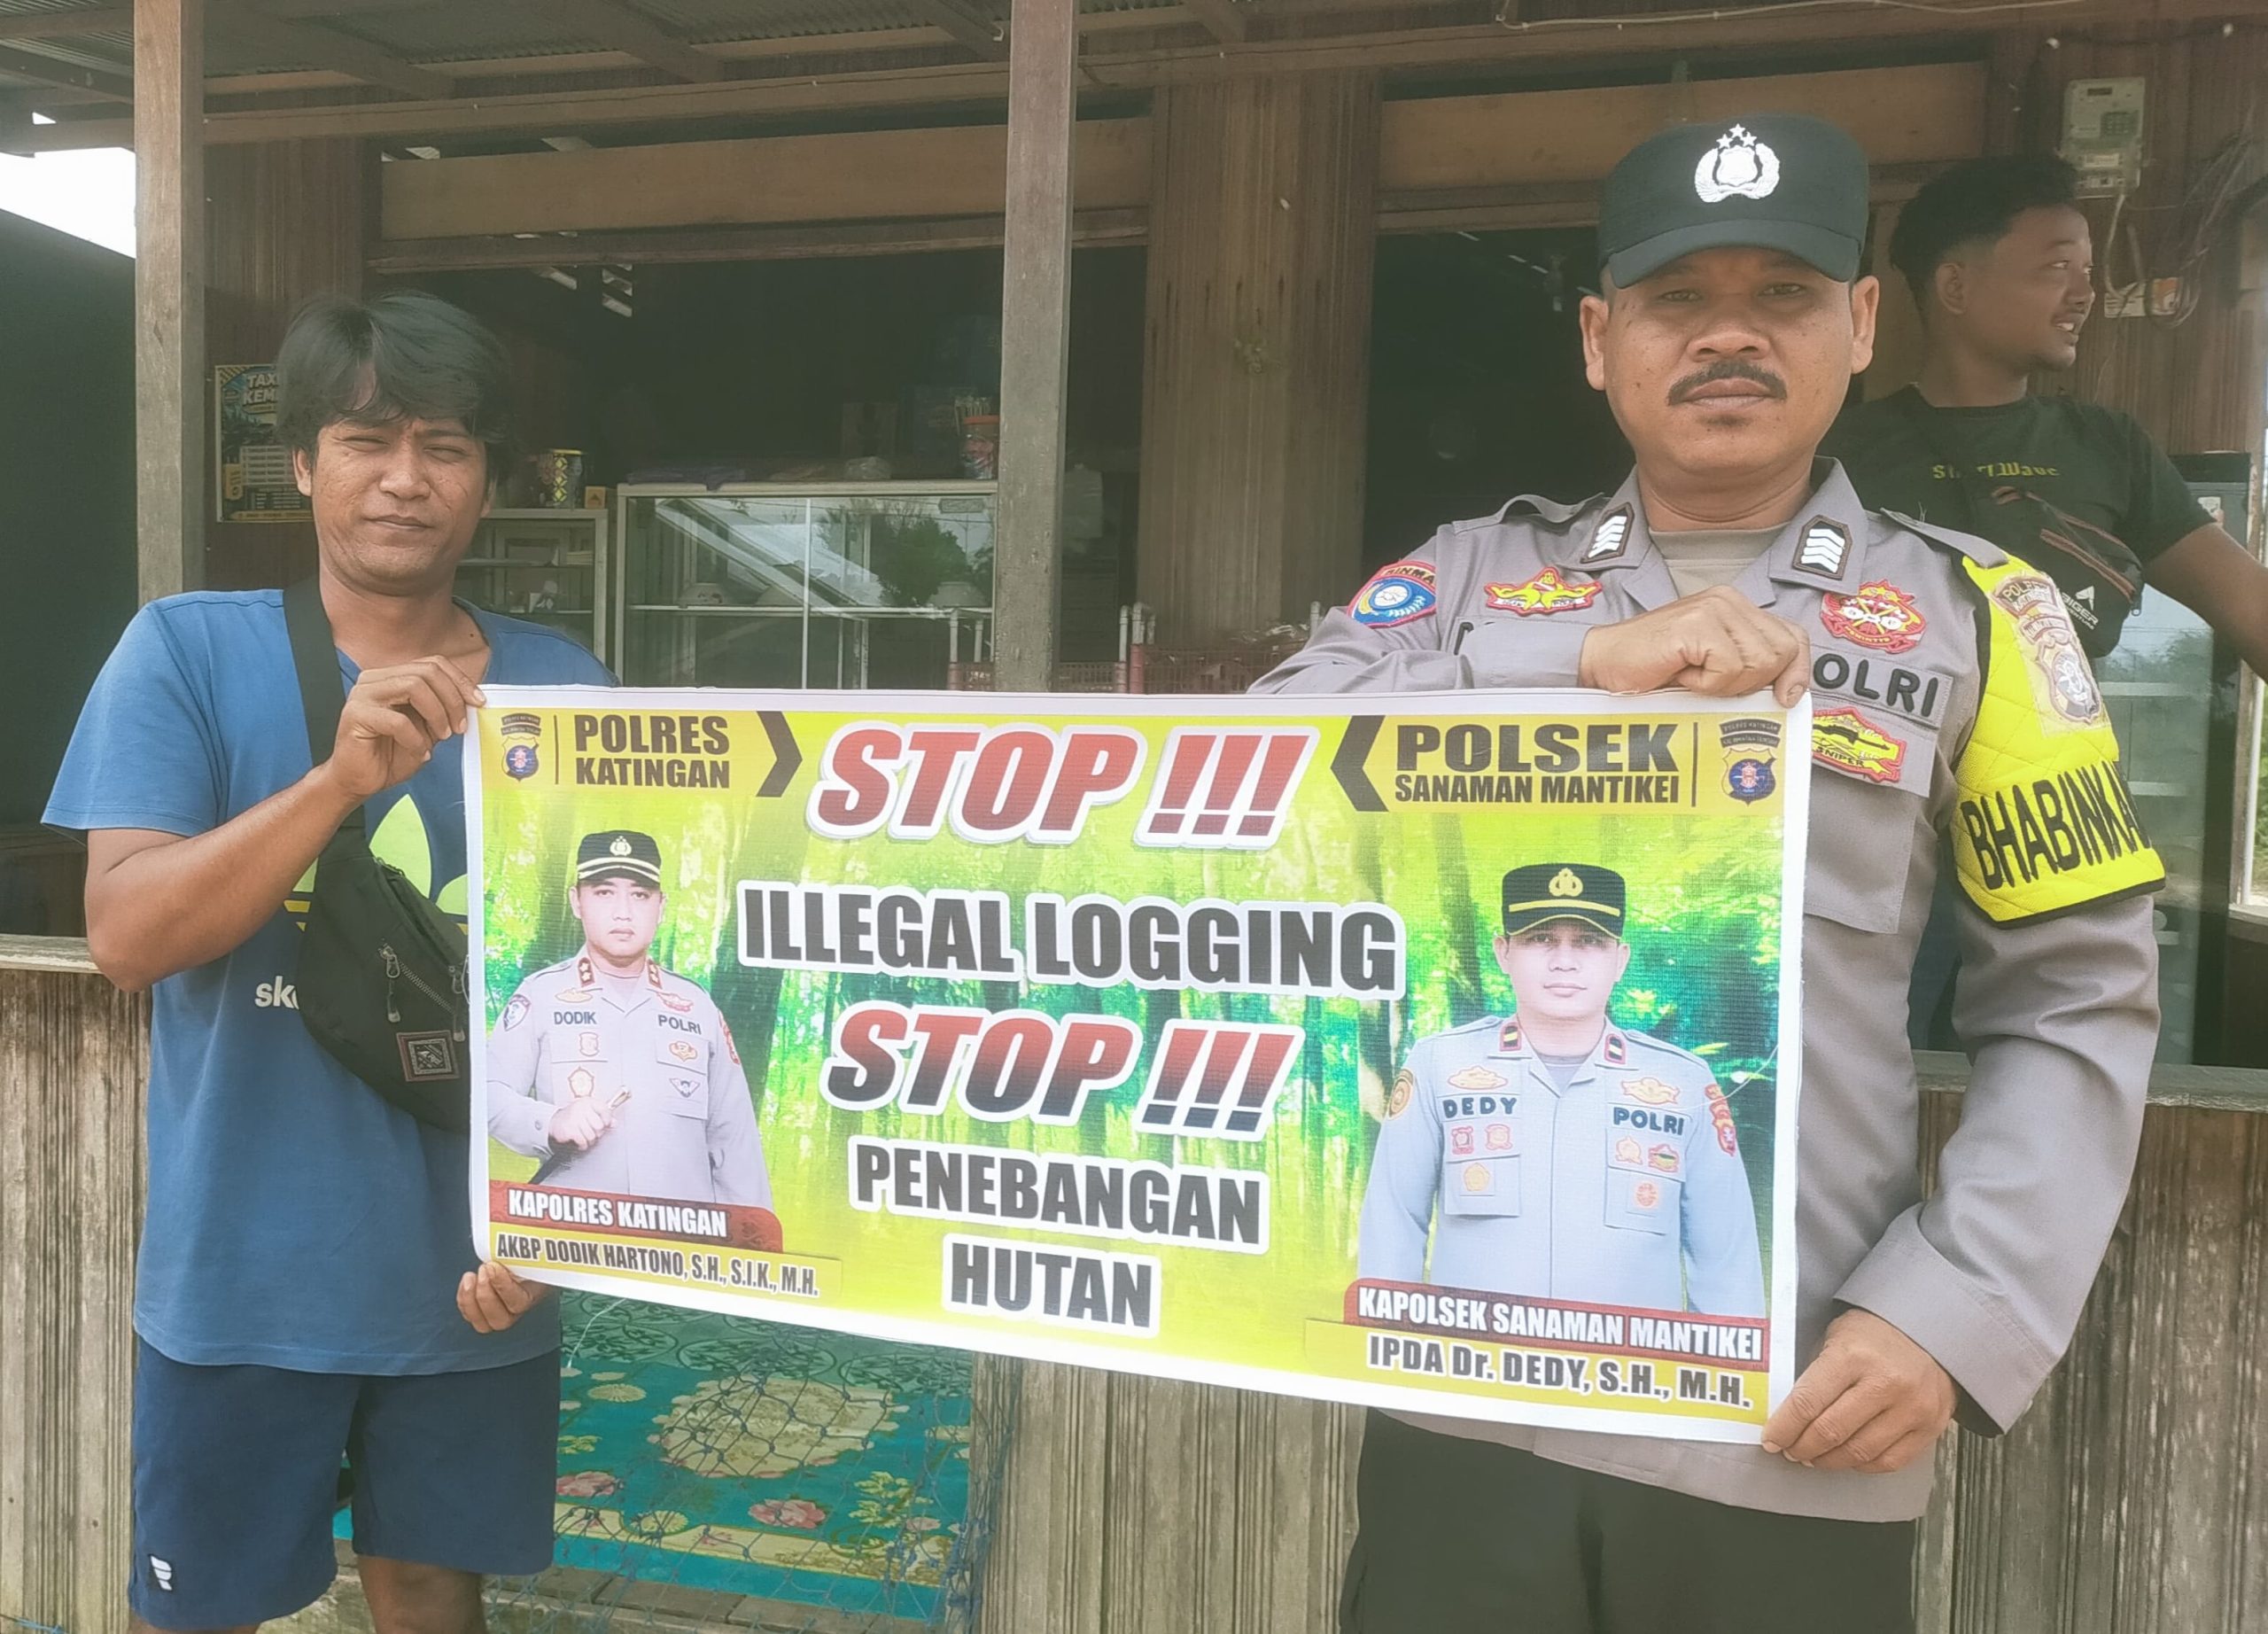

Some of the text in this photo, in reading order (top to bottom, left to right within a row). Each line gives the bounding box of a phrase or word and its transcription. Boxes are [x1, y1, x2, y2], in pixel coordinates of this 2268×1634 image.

[242, 388, 276, 405] KEM
[247, 372, 277, 387] TAX
[1813, 652, 1939, 718] OLRI
[574, 713, 731, 757] POLRES
[1395, 721, 1680, 774] POLSEK
[1814, 746, 1865, 768] SNIPER
[575, 758, 731, 790] KATINGAN
[818, 728, 1311, 837] STOP !!!
[1394, 774, 1680, 805] SANAMAN MANTIKEI
[1960, 759, 2152, 891] BHABINKA
[743, 887, 1398, 992] ILLEGAL LOGGING
[553, 1011, 598, 1026] DODIK
[657, 1014, 703, 1036] POLRI
[826, 1008, 1296, 1133] STOP !!!
[1441, 1096, 1518, 1119] DEDY
[1612, 1106, 1684, 1137] POLRI
[508, 1188, 727, 1238] KAPOLRES KATINGAN
[855, 1142, 1262, 1246] PENEBANGAN
[496, 1233, 819, 1297] AKBP DODIK HARTONO, S.H., S.I.K., M.H.
[950, 1241, 1153, 1329] HUTAN
[1358, 1286, 1762, 1361] KAPOLSEK SANAMAN MANTIKEI
[1369, 1335, 1752, 1409] IPDA Dr. DEDY, S.H., M.H.
